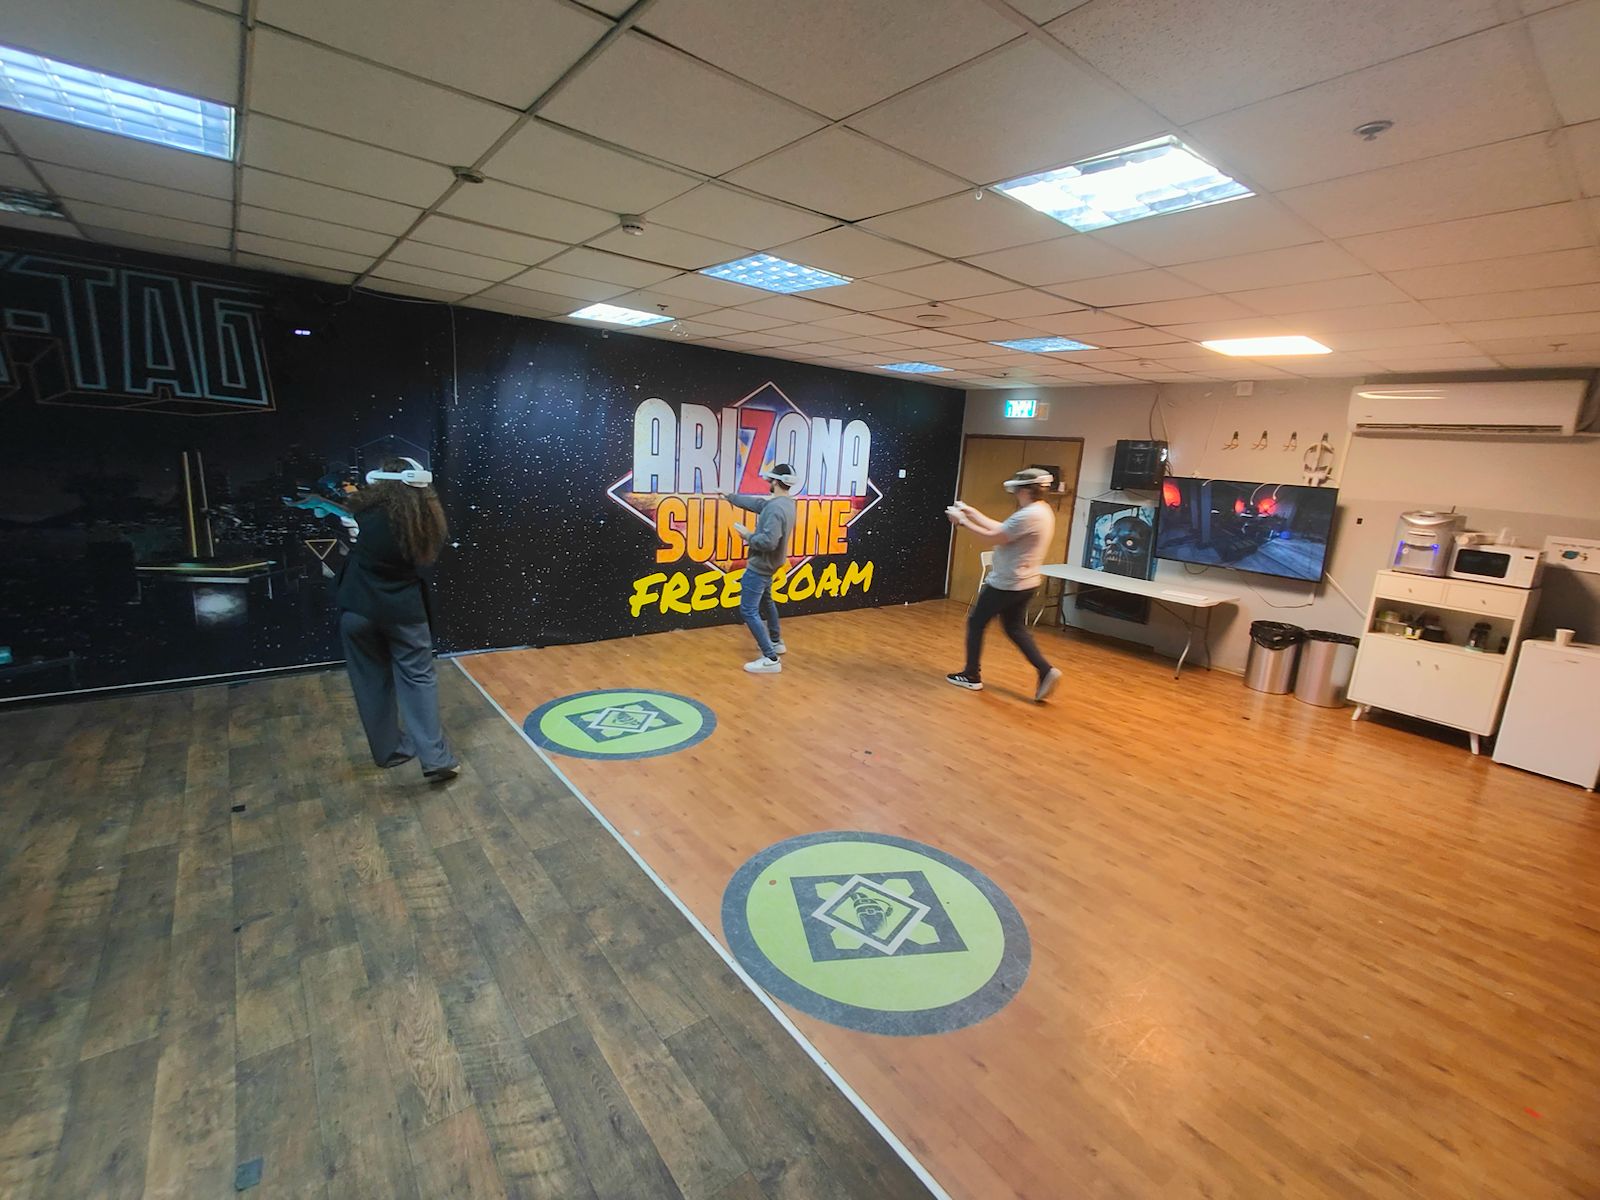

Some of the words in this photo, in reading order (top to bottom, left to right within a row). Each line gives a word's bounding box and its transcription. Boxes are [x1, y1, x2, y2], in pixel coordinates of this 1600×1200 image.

[0, 251, 269, 405] -TAG
[632, 398, 872, 497] ARIZONA
[656, 497, 850, 563] SUNINE
[629, 569, 743, 618] FREE
[771, 560, 874, 605] ROAM
